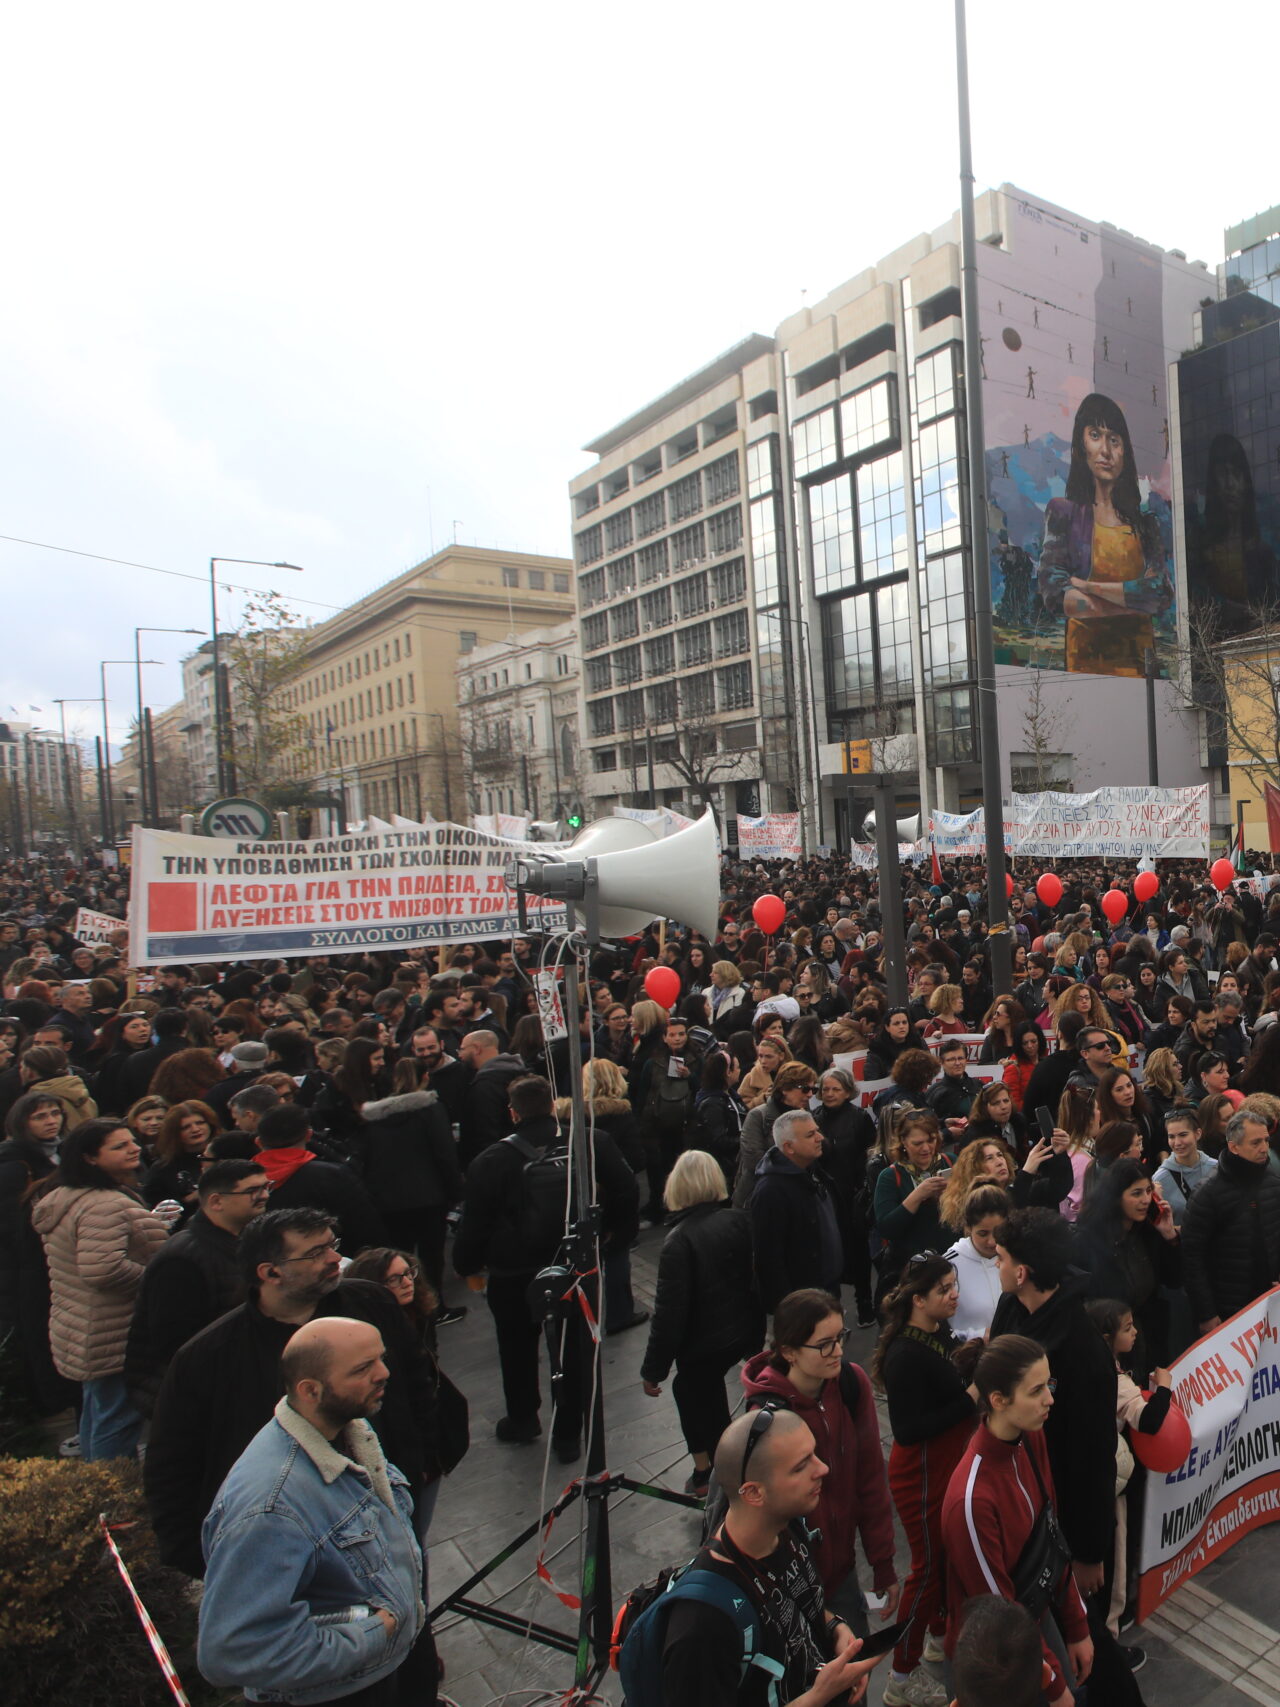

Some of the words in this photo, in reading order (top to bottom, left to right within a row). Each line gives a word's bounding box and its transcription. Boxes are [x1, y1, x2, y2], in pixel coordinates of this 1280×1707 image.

[1063, 822, 1082, 838] ΓΙΑ
[1129, 821, 1153, 838] ΚΑΙ
[237, 842, 308, 855] ΚΑΜΙΑ
[313, 835, 379, 854] ΑΝΟΧΗ
[384, 830, 431, 849] ΣΤΗΝ
[162, 856, 208, 875] ΤΗΝ
[213, 855, 353, 875] ΥΠΟΒΑΘΜΙΣΗ
[357, 853, 395, 870] ΤΩΝ
[400, 850, 477, 869] ΣΧΟΛΕΙΩΝ
[211, 883, 298, 905] ΛΕΦΤΑ
[305, 881, 341, 901] ΓΙΑ
[347, 875, 393, 899] ΤΗΝ
[398, 875, 481, 897] ΠΑΙΔΕΙΑ,
[211, 905, 316, 929] ΑΥΞΗΣΕΙΣ
[320, 902, 383, 922] ΣΤΟΥΣ
[389, 897, 464, 919] ΜΙΣΘΟΥΣ
[469, 895, 504, 914] ΤΩΝ
[311, 928, 412, 946] ΣΥΛΛΟΓΟΙ
[416, 923, 445, 939] ΚΑΙ
[450, 920, 497, 936] ΕΛΜΕ
